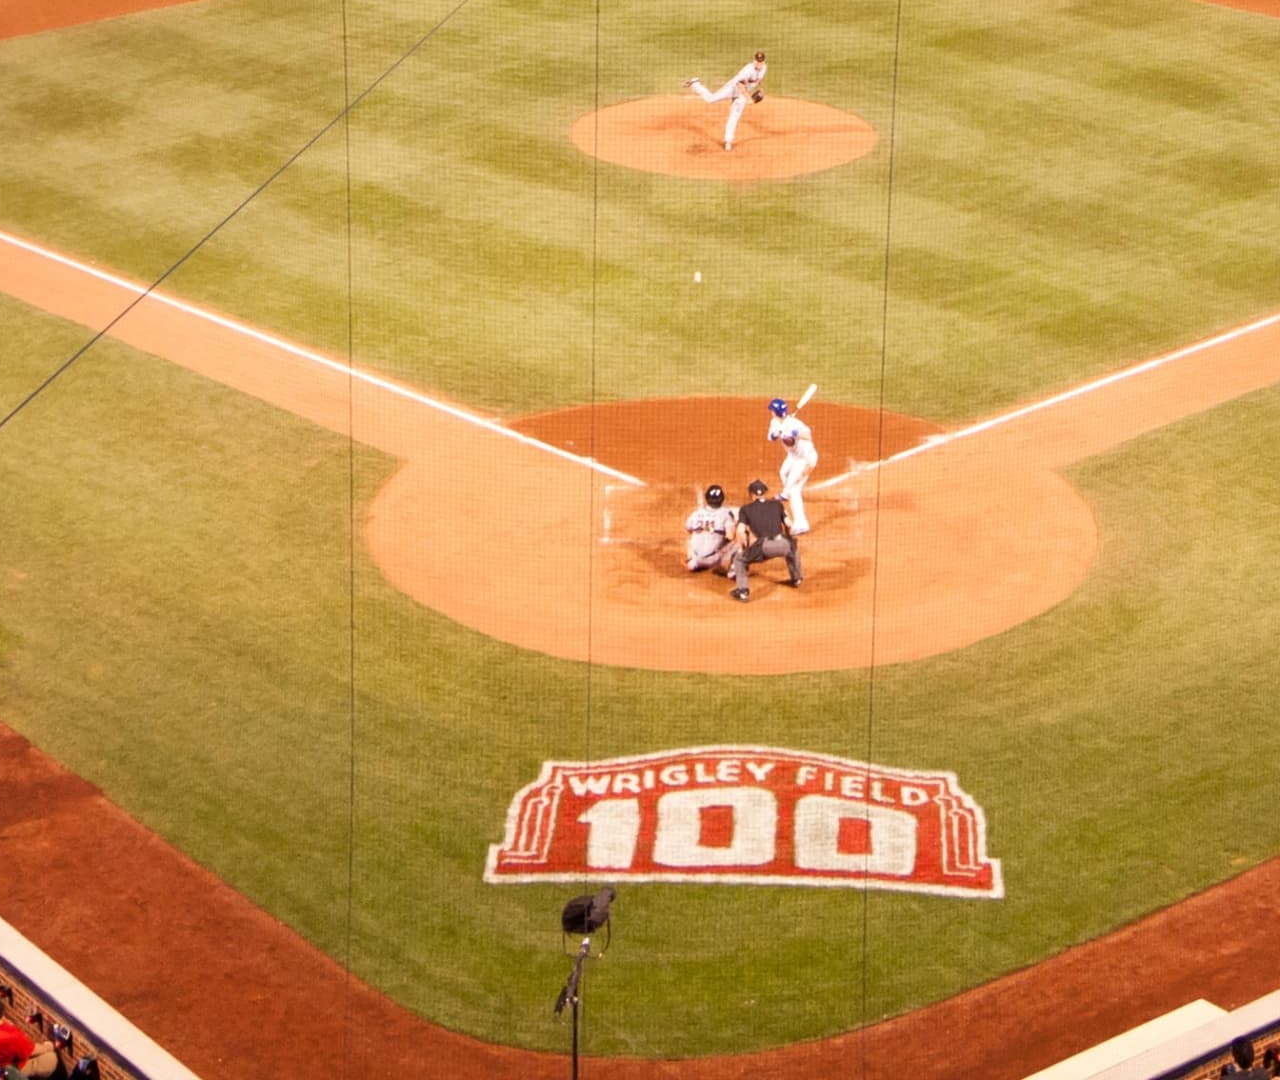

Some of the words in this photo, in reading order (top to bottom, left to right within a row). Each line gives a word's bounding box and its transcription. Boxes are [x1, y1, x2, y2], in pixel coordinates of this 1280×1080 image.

[567, 760, 774, 797] WRIGLEY
[795, 766, 932, 808] FIELD
[577, 786, 919, 877] 100
